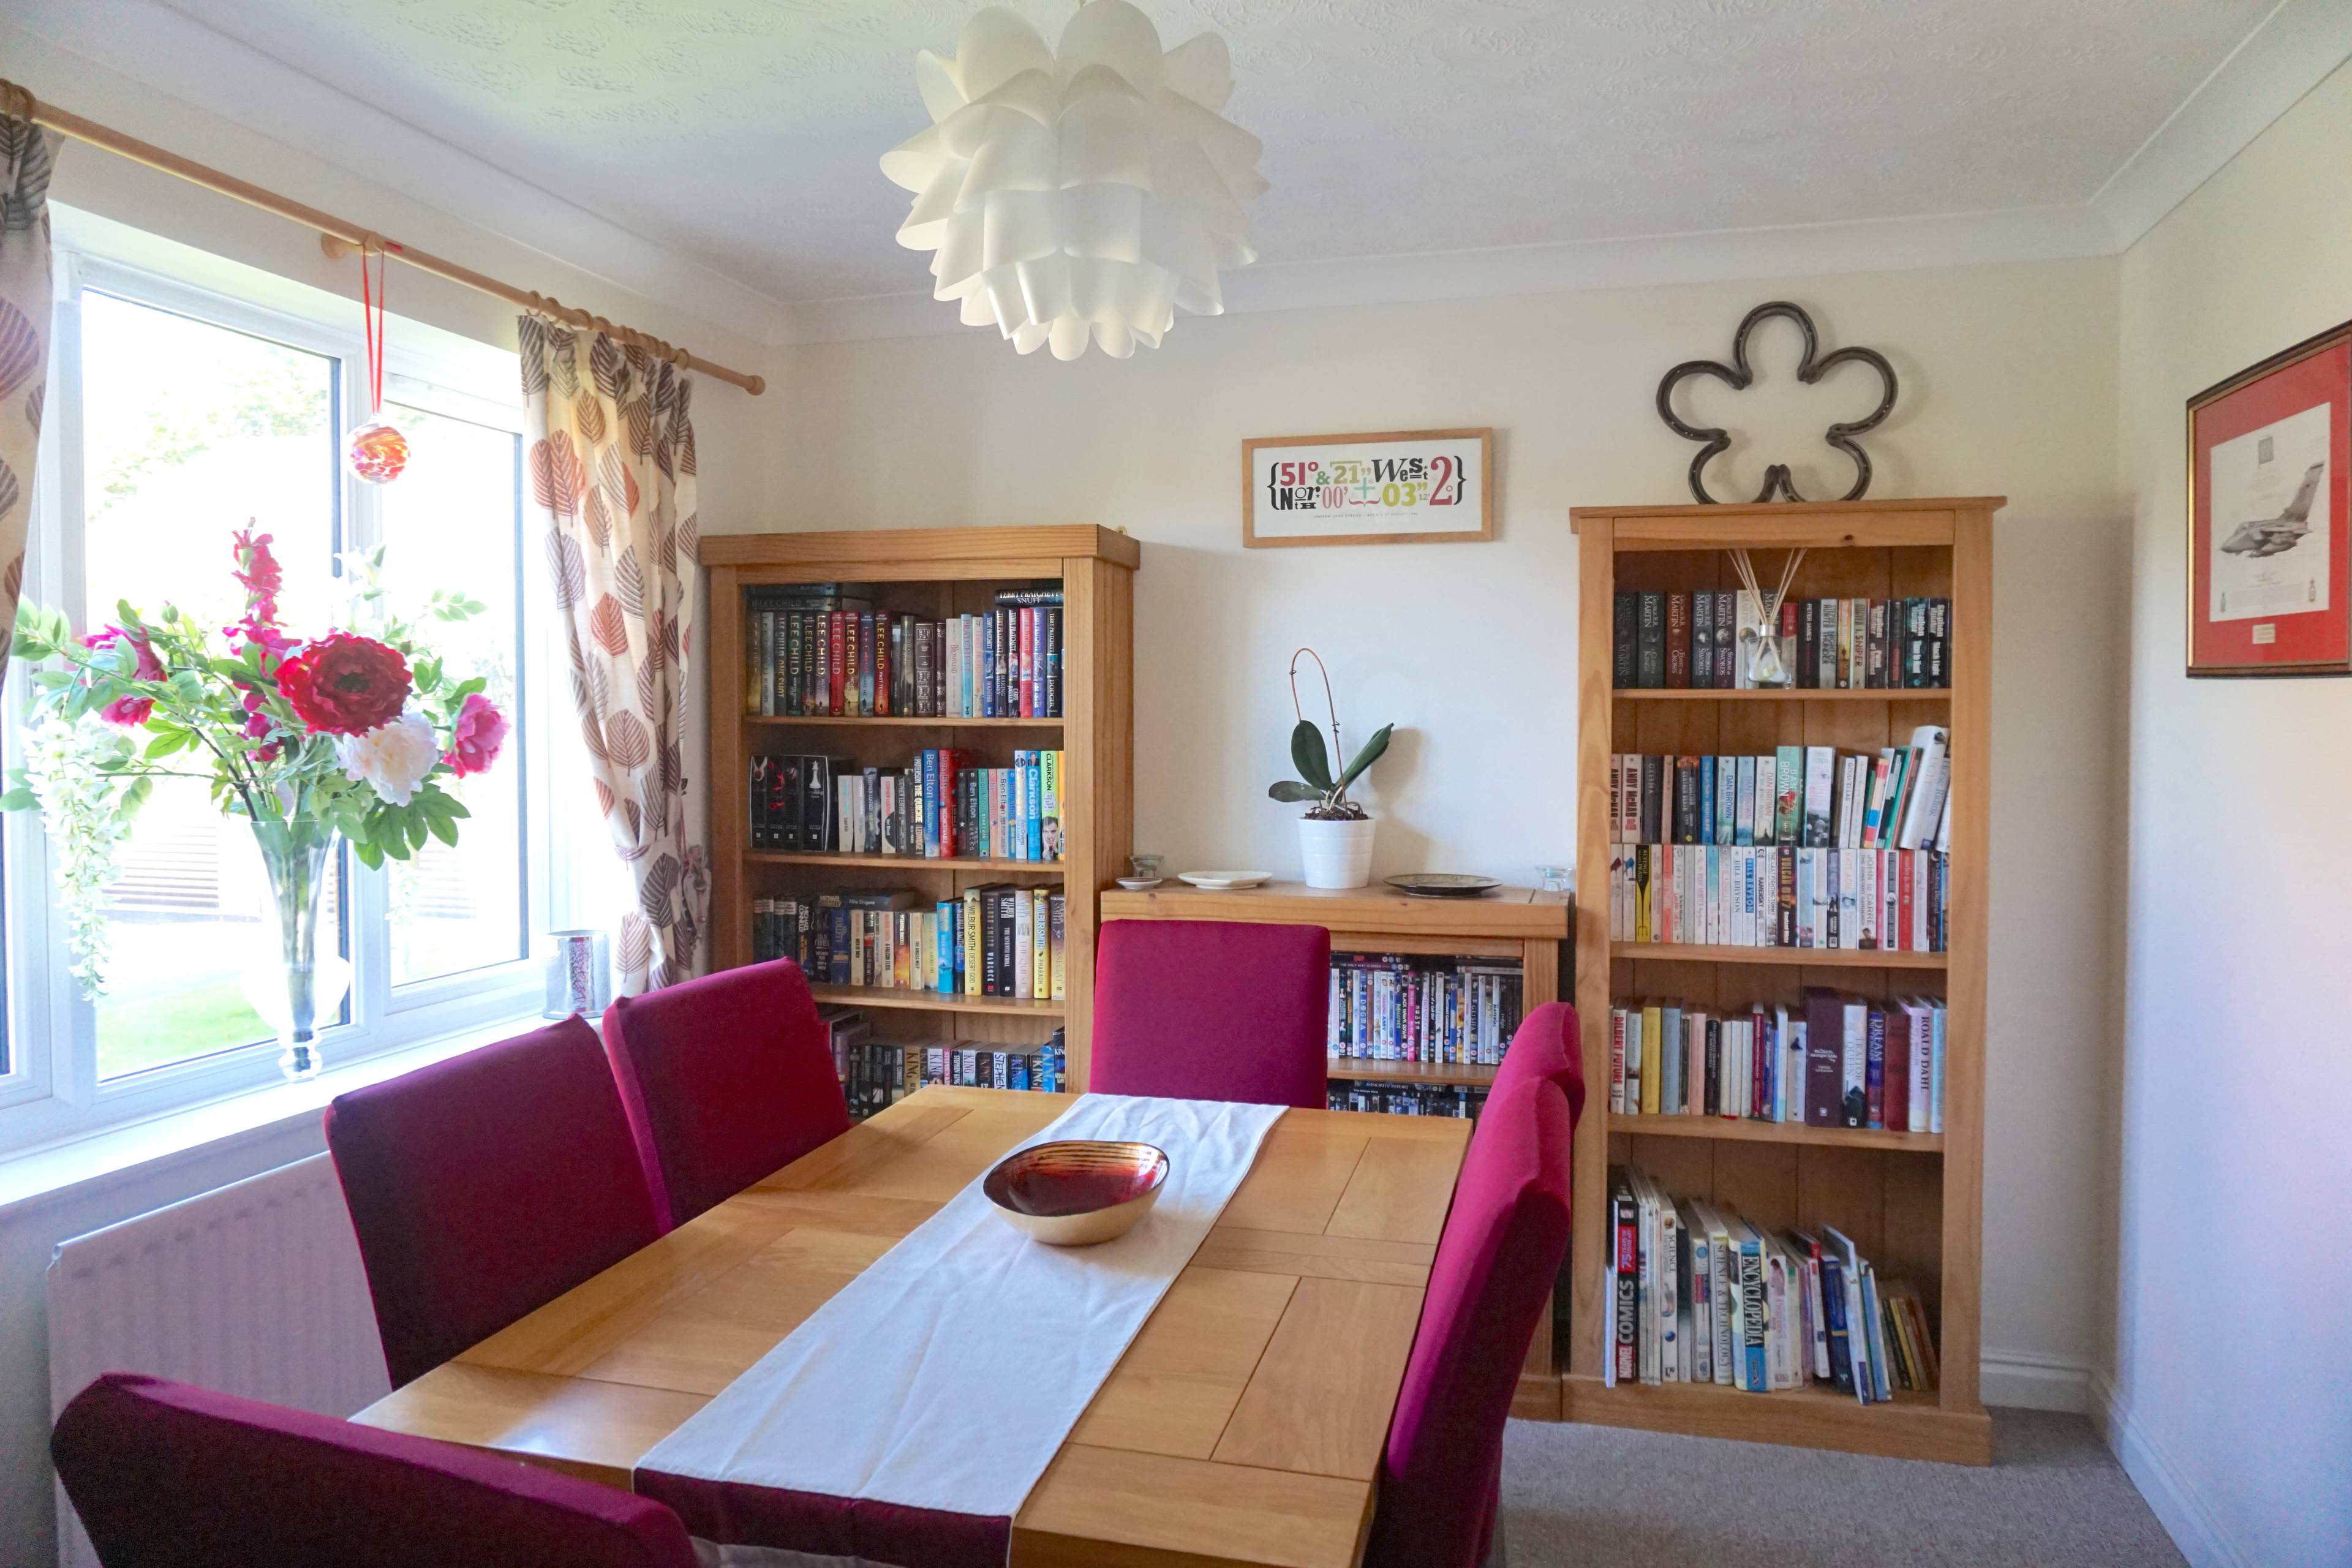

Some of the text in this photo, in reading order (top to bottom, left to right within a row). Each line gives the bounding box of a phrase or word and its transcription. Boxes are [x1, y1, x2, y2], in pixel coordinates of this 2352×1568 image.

[1644, 595, 1653, 628] MARTIN
[1672, 595, 1681, 628] MARTIN
[1696, 594, 1705, 627] MARTIN
[1717, 594, 1727, 627] MARTIN
[1876, 605, 1885, 638] Stephen
[1917, 603, 1926, 636] Stephen
[1936, 604, 1945, 638] Stephen
[790, 616, 799, 675] LEE CHILD
[804, 644, 813, 673] CHILD
[816, 615, 826, 675] LEE CHILD
[832, 622, 841, 675] LEE CHILD
[862, 645, 870, 674] CHILD
[876, 641, 885, 670] CHILD
[950, 644, 959, 674] BROMELIAD
[1719, 647, 1727, 676] SWORDS
[1829, 655, 1836, 666] OF
[1854, 635, 1864, 667] SNIPER
[1671, 650, 1679, 674] CROWS
[1697, 648, 1706, 676] SWORDS
[926, 754, 936, 799] Ben Elton
[940, 775, 949, 801] Elton
[1610, 768, 1619, 818] ANDY McNAB
[1625, 767, 1638, 818] ANDY McNAB
[1779, 761, 1790, 797] BROWN
[1789, 769, 1798, 790] DAN
[914, 797, 922, 823] QUICKIE
[1028, 768, 1038, 820] Clarkson
[1764, 772, 1774, 816] DAN BROWN
[1781, 857, 1792, 884] VULCAN
[1036, 904, 1046, 929] WILBUR
[1036, 929, 1046, 949] SMITH
[1612, 1016, 1624, 1085] DILBERT FUTURE
[1874, 1018, 1885, 1061] DREAM
[1921, 1016, 1930, 1093] ROALD DAHL
[906, 1053, 919, 1079] KING
[929, 1054, 942, 1076] KING
[963, 1054, 974, 1074] KING
[979, 1057, 991, 1081] KING
[994, 1054, 1006, 1090] STEPHEN
[1032, 1060, 1043, 1086] KING
[1846, 1041, 1855, 1076] QUEEN
[1855, 1038, 1864, 1081] TRAITOR
[1667, 1234, 1676, 1275] SCIENCE
[1716, 1242, 1727, 1286] SCIENCE
[1742, 1255, 1764, 1346] ENCYCLOPEDIA
[1618, 1280, 1635, 1379] MARVEL COMICS
[1717, 1300, 1730, 1368] TECHNOLOGY
